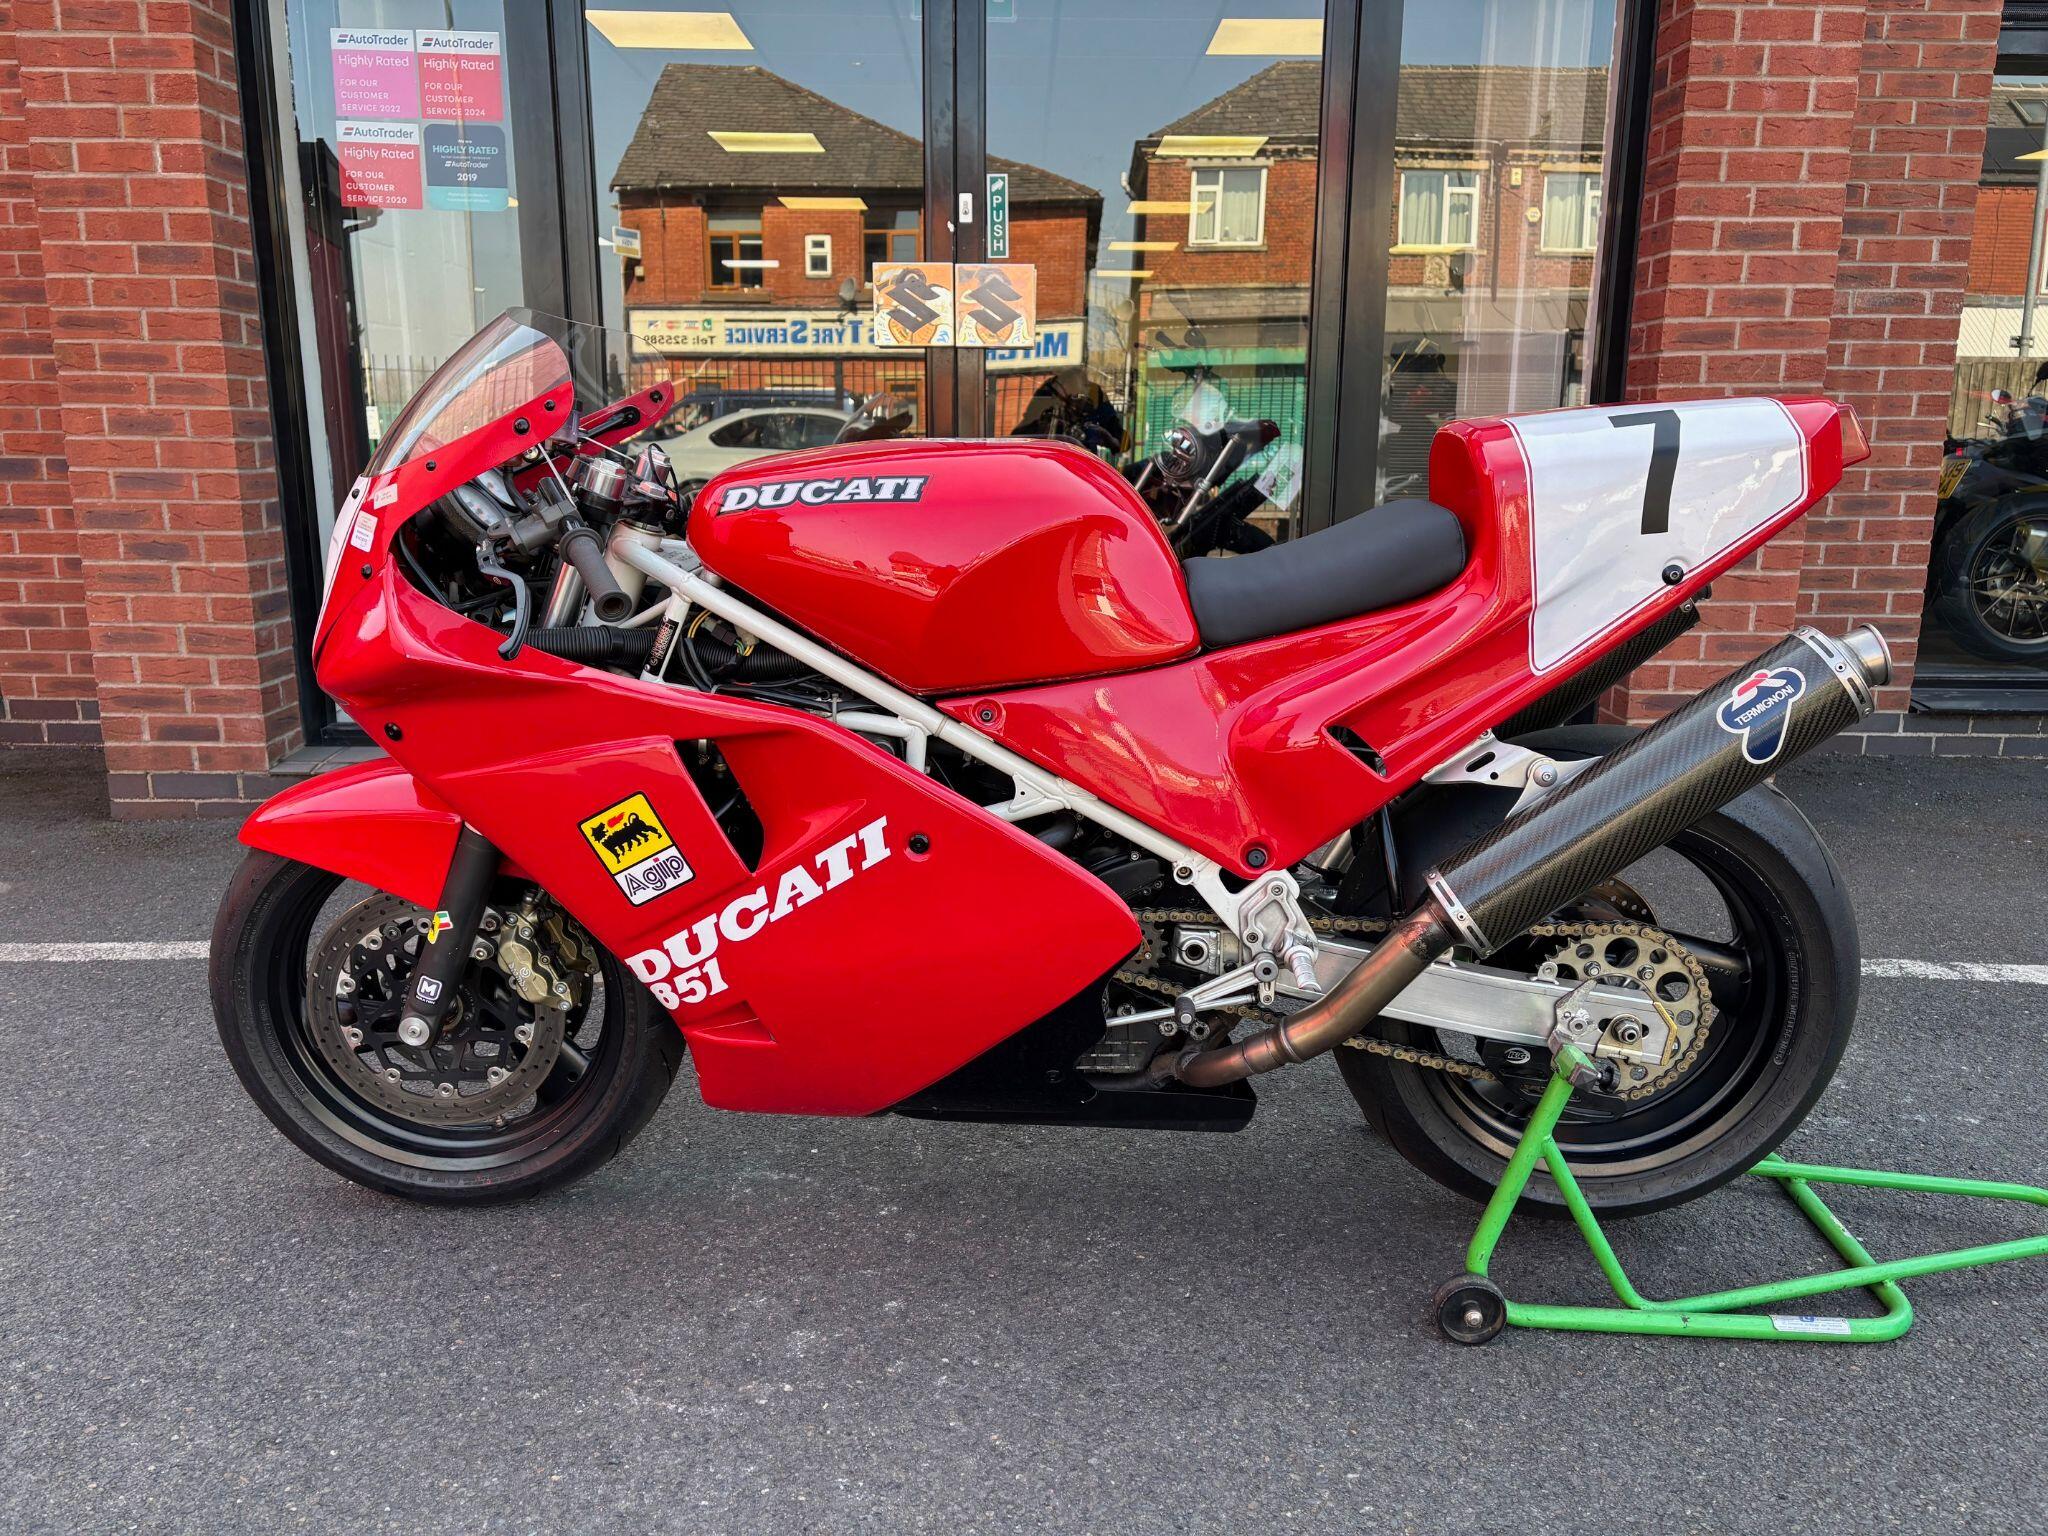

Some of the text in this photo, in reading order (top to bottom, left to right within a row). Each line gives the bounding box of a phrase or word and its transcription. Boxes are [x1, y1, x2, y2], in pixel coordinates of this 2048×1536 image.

[348, 34, 408, 46] AutoTrader
[433, 38, 493, 49] AutoTrader
[338, 55, 409, 68] Highly Rated
[423, 58, 494, 71] Highly Rated
[340, 79, 378, 87] FOR OUR
[424, 82, 463, 91] FOR OUR
[340, 91, 389, 100] CUSTOMER
[425, 94, 474, 104] CUSTOMER
[341, 103, 401, 113] SERVICE 2022
[426, 107, 486, 117] SERVICE 2024
[353, 127, 414, 139] AutoTrader
[344, 147, 414, 160] Highly Rated
[432, 145, 498, 155] HIGHLY RATED
[451, 160, 488, 169] AutoTrader
[345, 170, 384, 179] FOR OUR
[456, 173, 478, 182] 2019
[346, 183, 395, 192] CUSTOMER
[346, 195, 407, 204] SERVICE 2020
[992, 196, 1004, 251] PUSH
[1607, 409, 1681, 535] 7
[719, 476, 928, 514] DUCATI
[1734, 685, 1795, 727] TERMIGNONI
[621, 855, 685, 897] Agip
[624, 815, 891, 983] DUCATI
[420, 980, 437, 997] M
[650, 957, 729, 1010] 851
